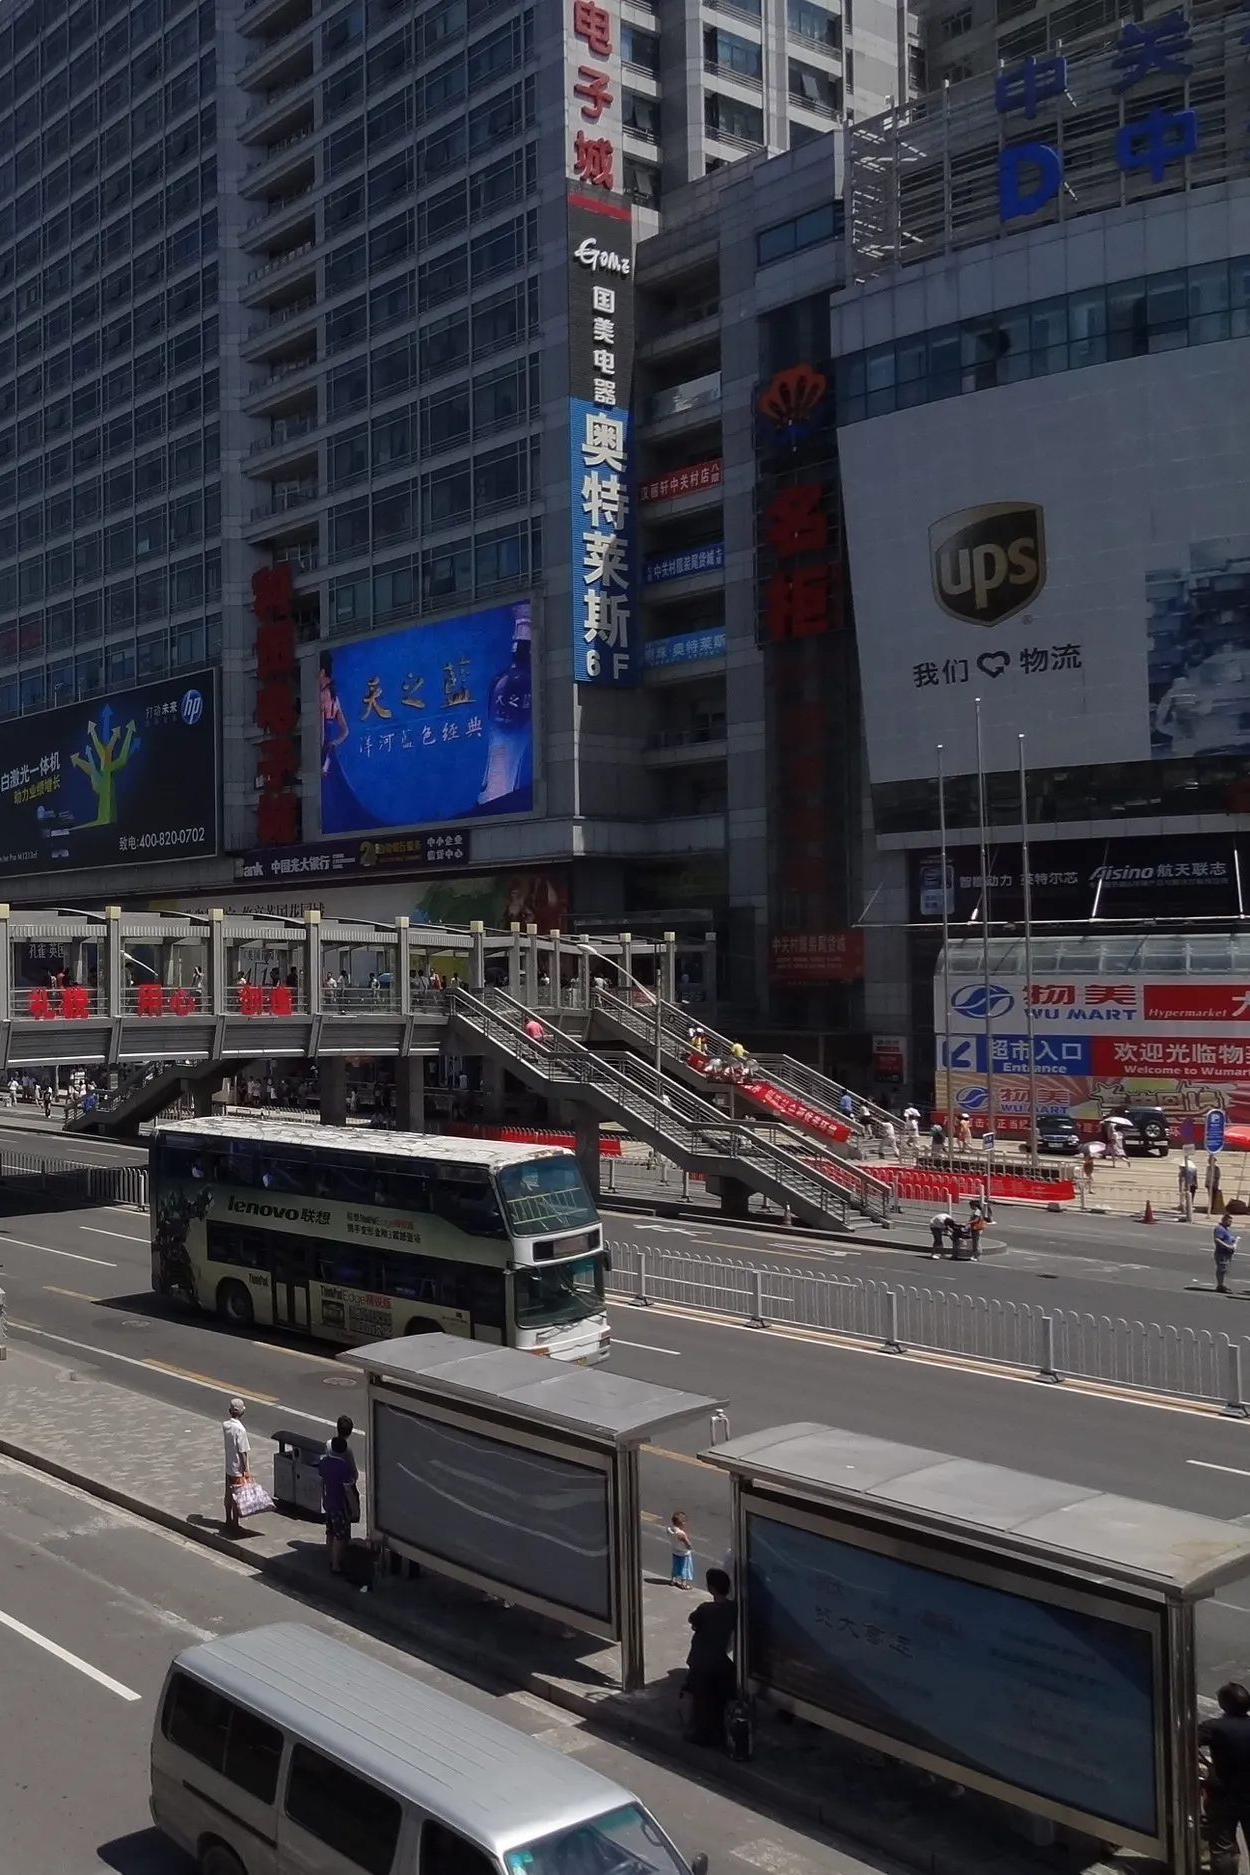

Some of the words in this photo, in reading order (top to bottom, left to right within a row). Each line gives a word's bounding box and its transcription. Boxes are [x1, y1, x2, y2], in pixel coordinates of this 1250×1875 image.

[573, 0, 613, 190] 电子城
[592, 285, 616, 406] 国美电器
[582, 411, 631, 648] 奥特莱斯
[939, 537, 1038, 610] ups
[913, 659, 969, 688] 我们
[1019, 643, 1082, 675] 物流
[271, 855, 330, 875] 中国光大银行
[1023, 984, 1136, 1006] 物美
[1023, 1008, 1060, 1020] WU
[1063, 1008, 1137, 1021] MART
[1149, 1006, 1228, 1019] Hypermarket
[991, 1039, 1083, 1062] 超市入口
[1125, 1065, 1182, 1076] Welcome
[1184, 1065, 1198, 1076] to
[228, 1195, 299, 1221] lenovo
[300, 1207, 331, 1225] 联想
